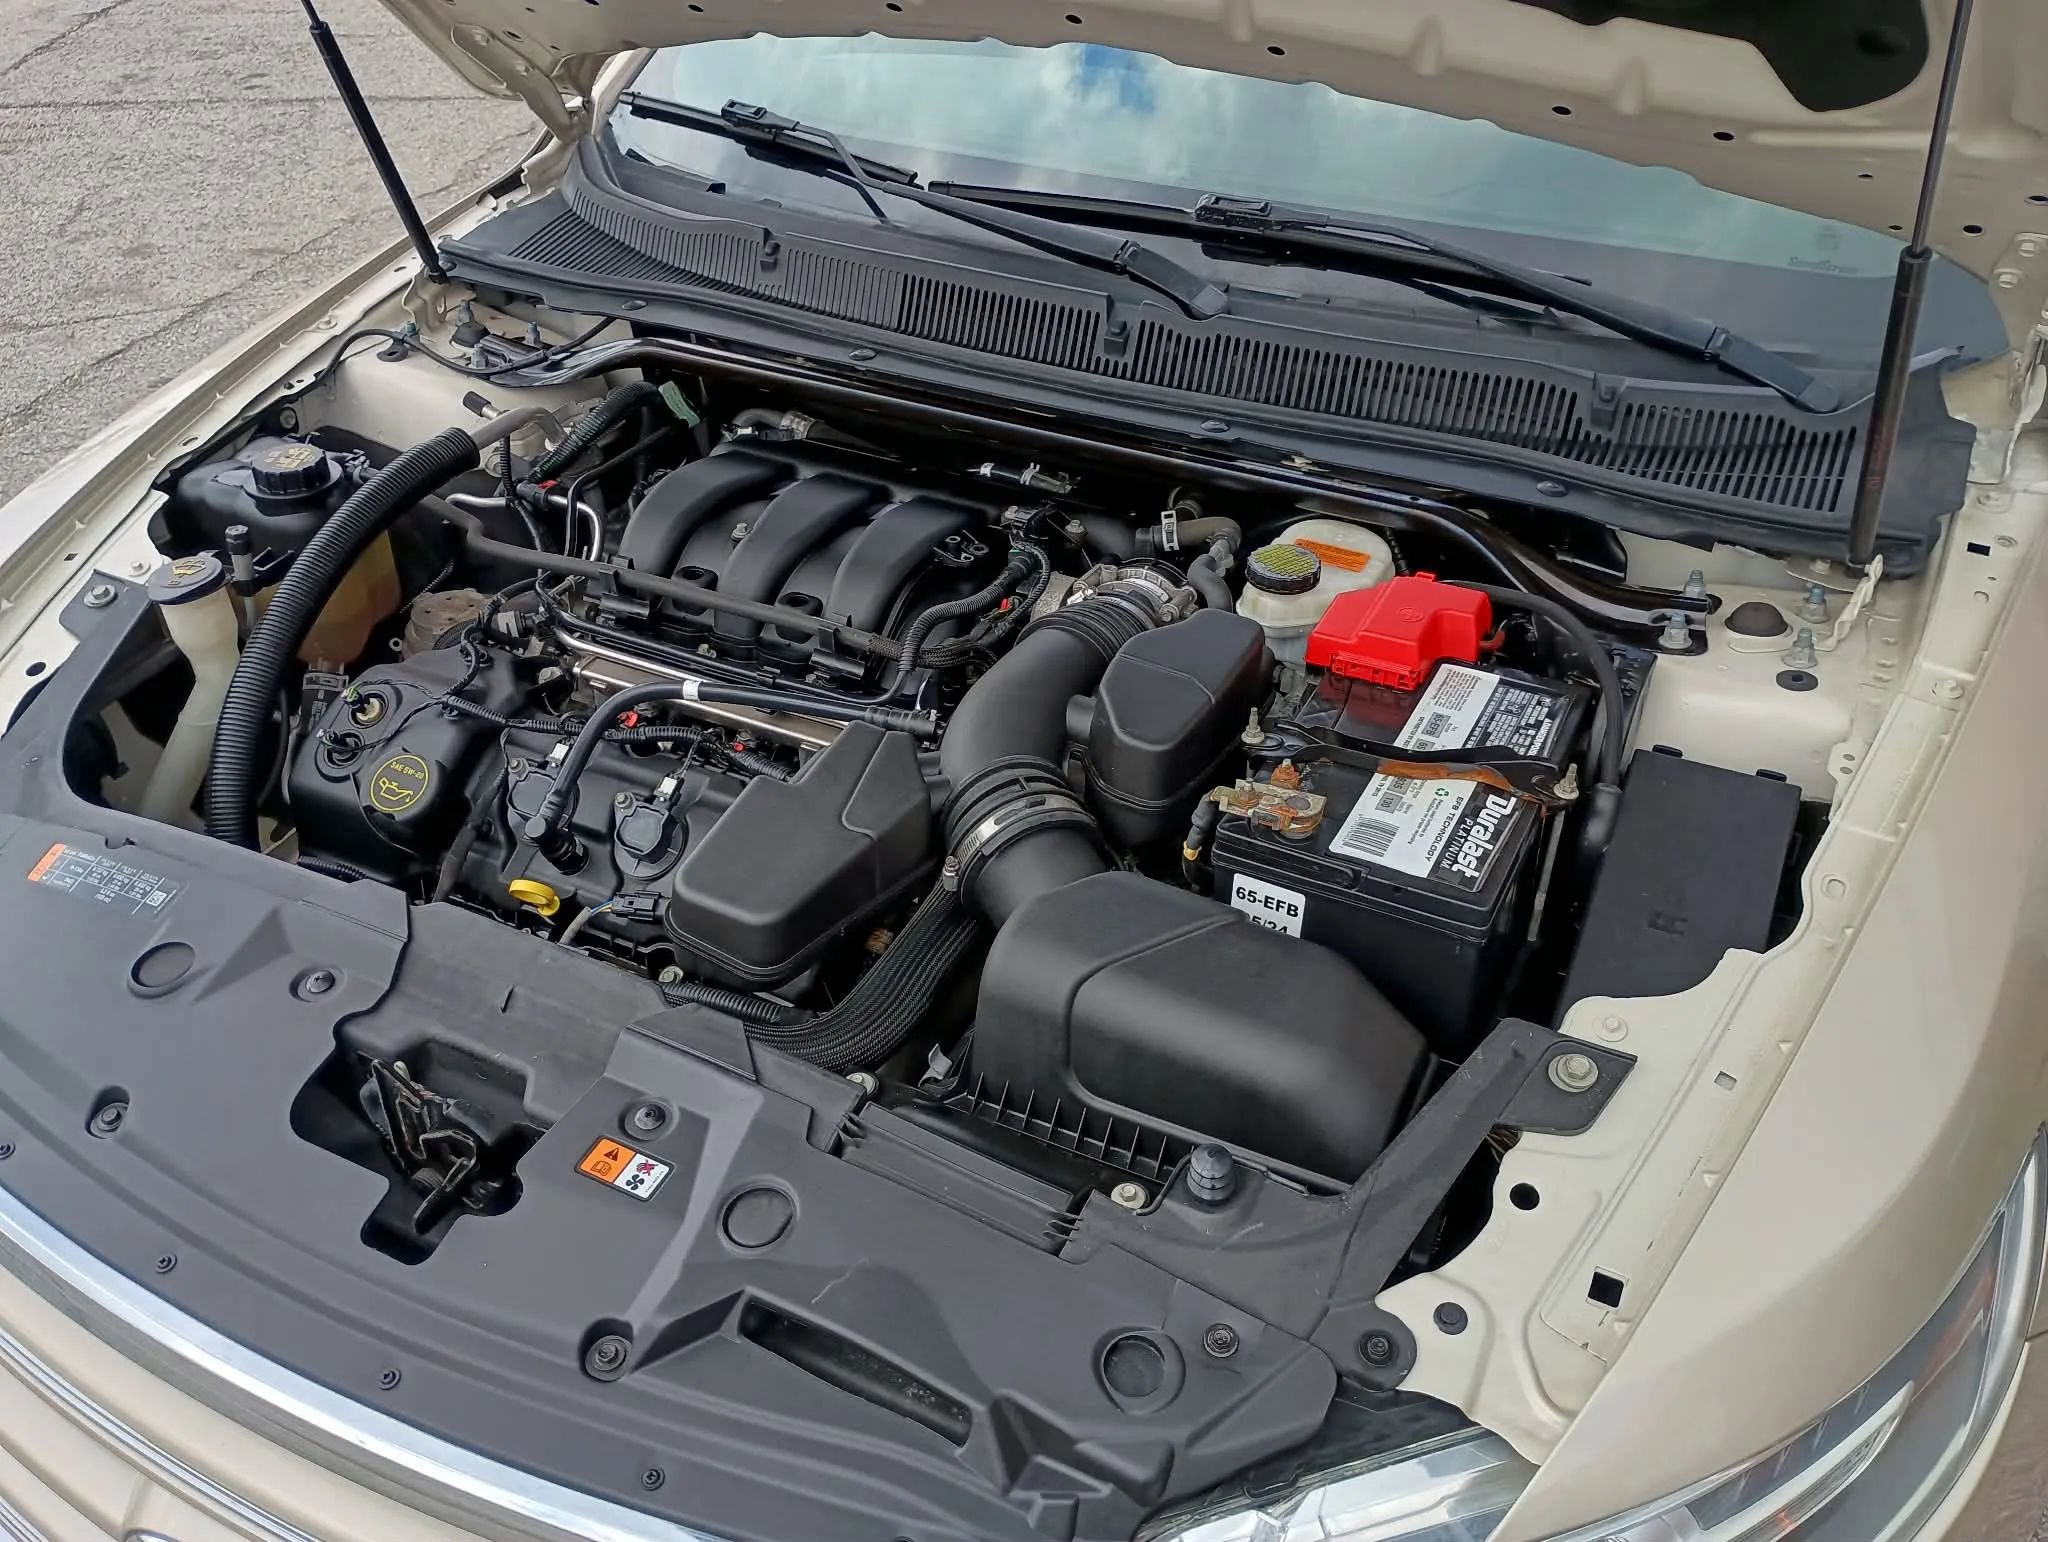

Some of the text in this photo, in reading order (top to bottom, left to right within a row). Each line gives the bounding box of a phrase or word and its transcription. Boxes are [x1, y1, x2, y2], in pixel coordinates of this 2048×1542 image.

[390, 761, 425, 779] SAE 5W-20
[1426, 796, 1464, 862] EFB TECHNOLOGY
[1440, 817, 1473, 868] PLATINUM
[1450, 793, 1518, 878] Duralast
[1236, 886, 1299, 918] 65-EFB
